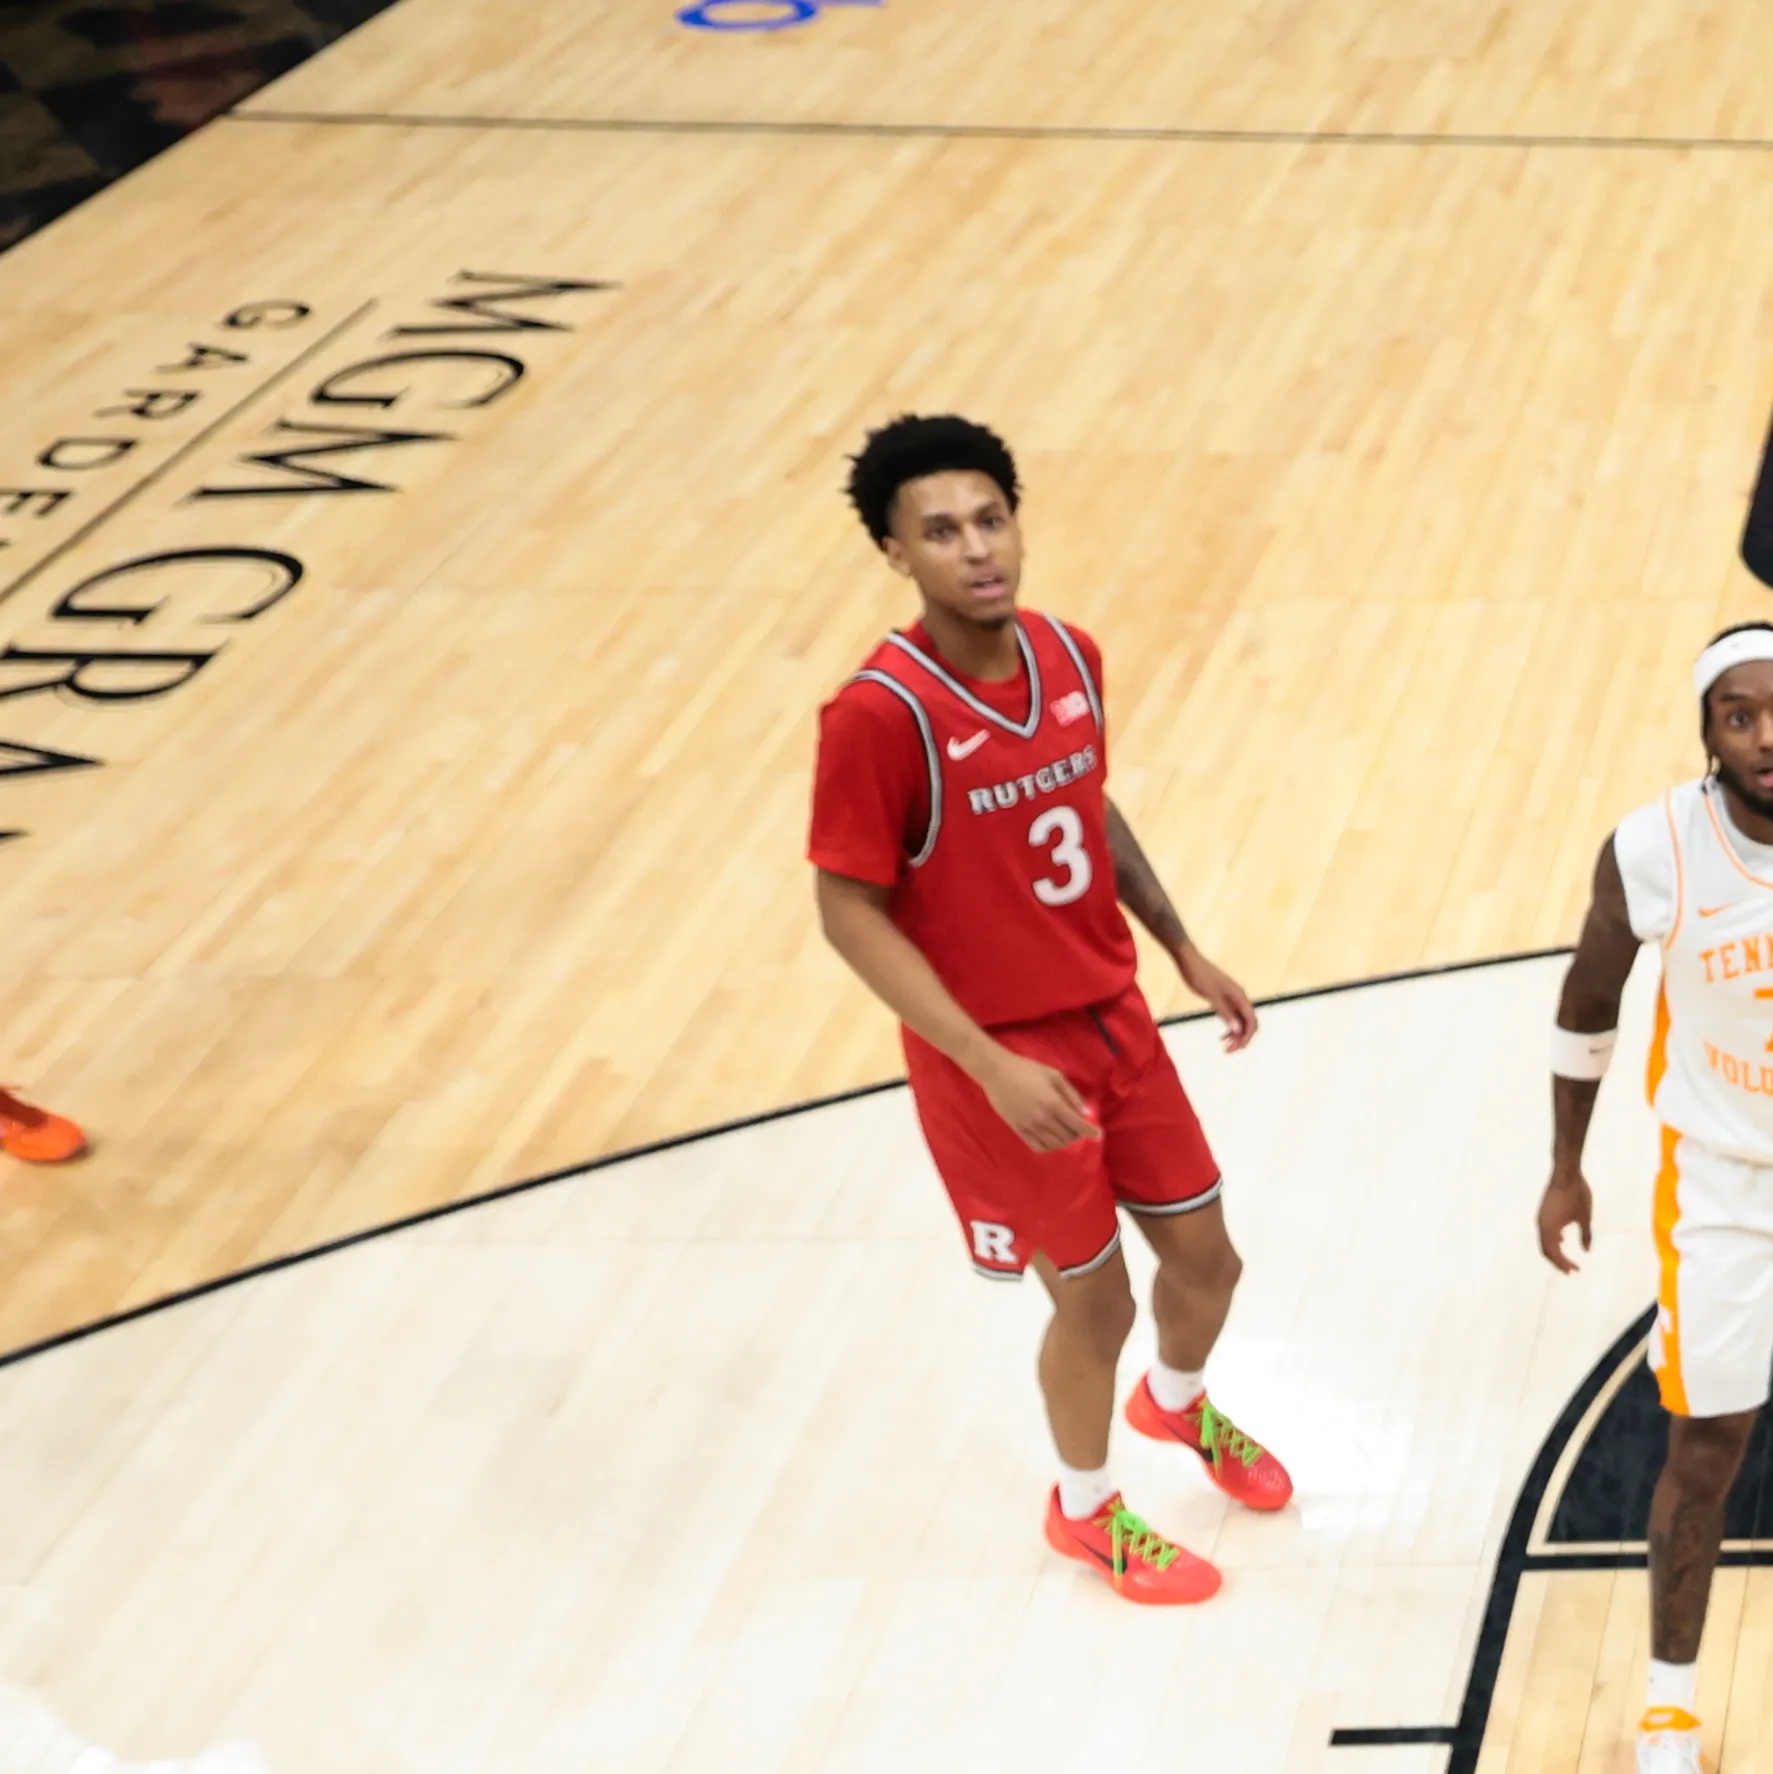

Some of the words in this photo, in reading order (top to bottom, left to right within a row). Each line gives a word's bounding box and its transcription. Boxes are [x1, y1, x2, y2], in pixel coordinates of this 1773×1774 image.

[0, 298, 312, 547] GARDE
[172, 268, 624, 506] MGM
[0, 546, 304, 845] GRA
[967, 743, 1098, 816] RUTGERS
[1028, 804, 1093, 907] 3
[971, 1219, 1015, 1262] R
